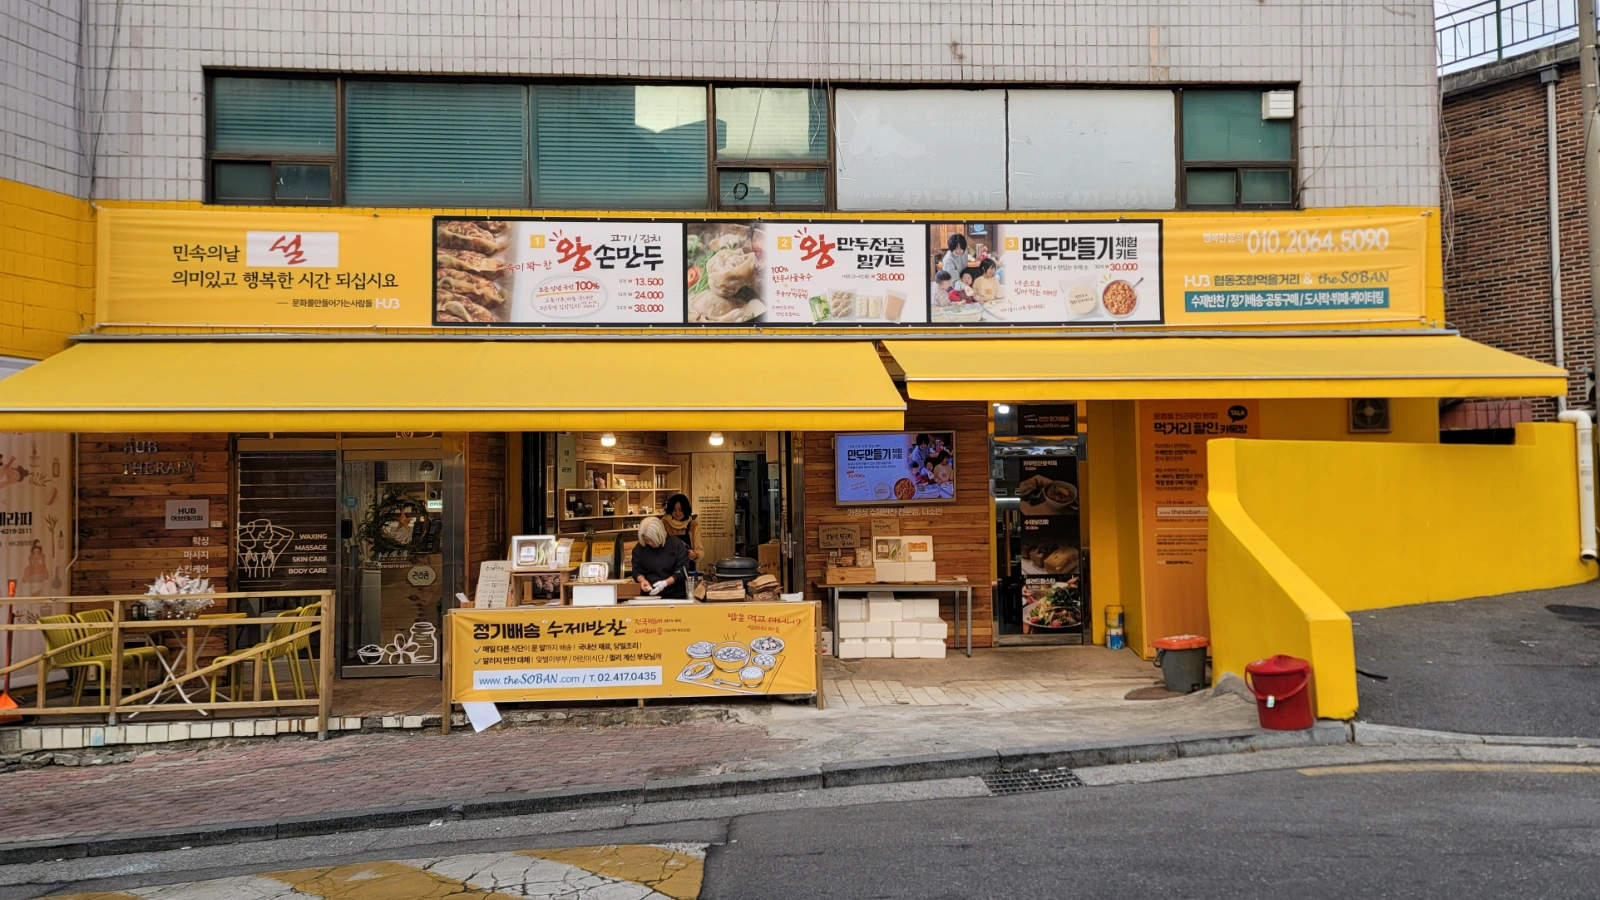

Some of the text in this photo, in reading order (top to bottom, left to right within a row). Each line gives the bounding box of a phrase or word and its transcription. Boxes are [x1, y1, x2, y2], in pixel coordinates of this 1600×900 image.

[533, 237, 540, 247] 1
[781, 238, 788, 248] 2
[1007, 239, 1015, 248] 3
[1228, 232, 1244, 243] 문의
[1247, 227, 1389, 254] 010.2064.5090
[172, 234, 307, 266] 민속의날 설
[554, 236, 665, 273] 왕 손만두
[799, 234, 905, 270] 왕 만두전골
[1022, 236, 1138, 261] 만두만들기 체험
[1115, 249, 1138, 260] 키트
[857, 254, 905, 270] 밀키트
[171, 270, 399, 291] 의미있고 행복한 시간 되십시요
[575, 280, 600, 291] 100%
[1184, 274, 1211, 287] HUB
[1213, 273, 1300, 287] 협동조합먹을거리
[1303, 272, 1313, 285] &
[375, 297, 400, 309] HUB
[1153, 421, 1192, 435] 먹거리
[1194, 421, 1219, 435] 할인
[123, 440, 158, 455] HUB
[847, 448, 891, 461] 만두만들기
[121, 461, 196, 475] THERAPY
[178, 507, 196, 515] HUB
[299, 533, 328, 541] WAXING
[294, 544, 328, 552] MASSAGE
[183, 550, 209, 560] 마사지
[288, 567, 308, 575] BODY
[727, 612, 745, 622] 밥은
[747, 613, 767, 624] 먹고
[473, 622, 540, 640] 정기배송
[483, 645, 496, 653] 매일
[578, 643, 597, 651] 국내산
[503, 656, 516, 664] 반찬
[536, 655, 568, 663] 맞벌이부부
[573, 654, 604, 662] 어린이식단
[597, 672, 657, 683] 02.417.0435
